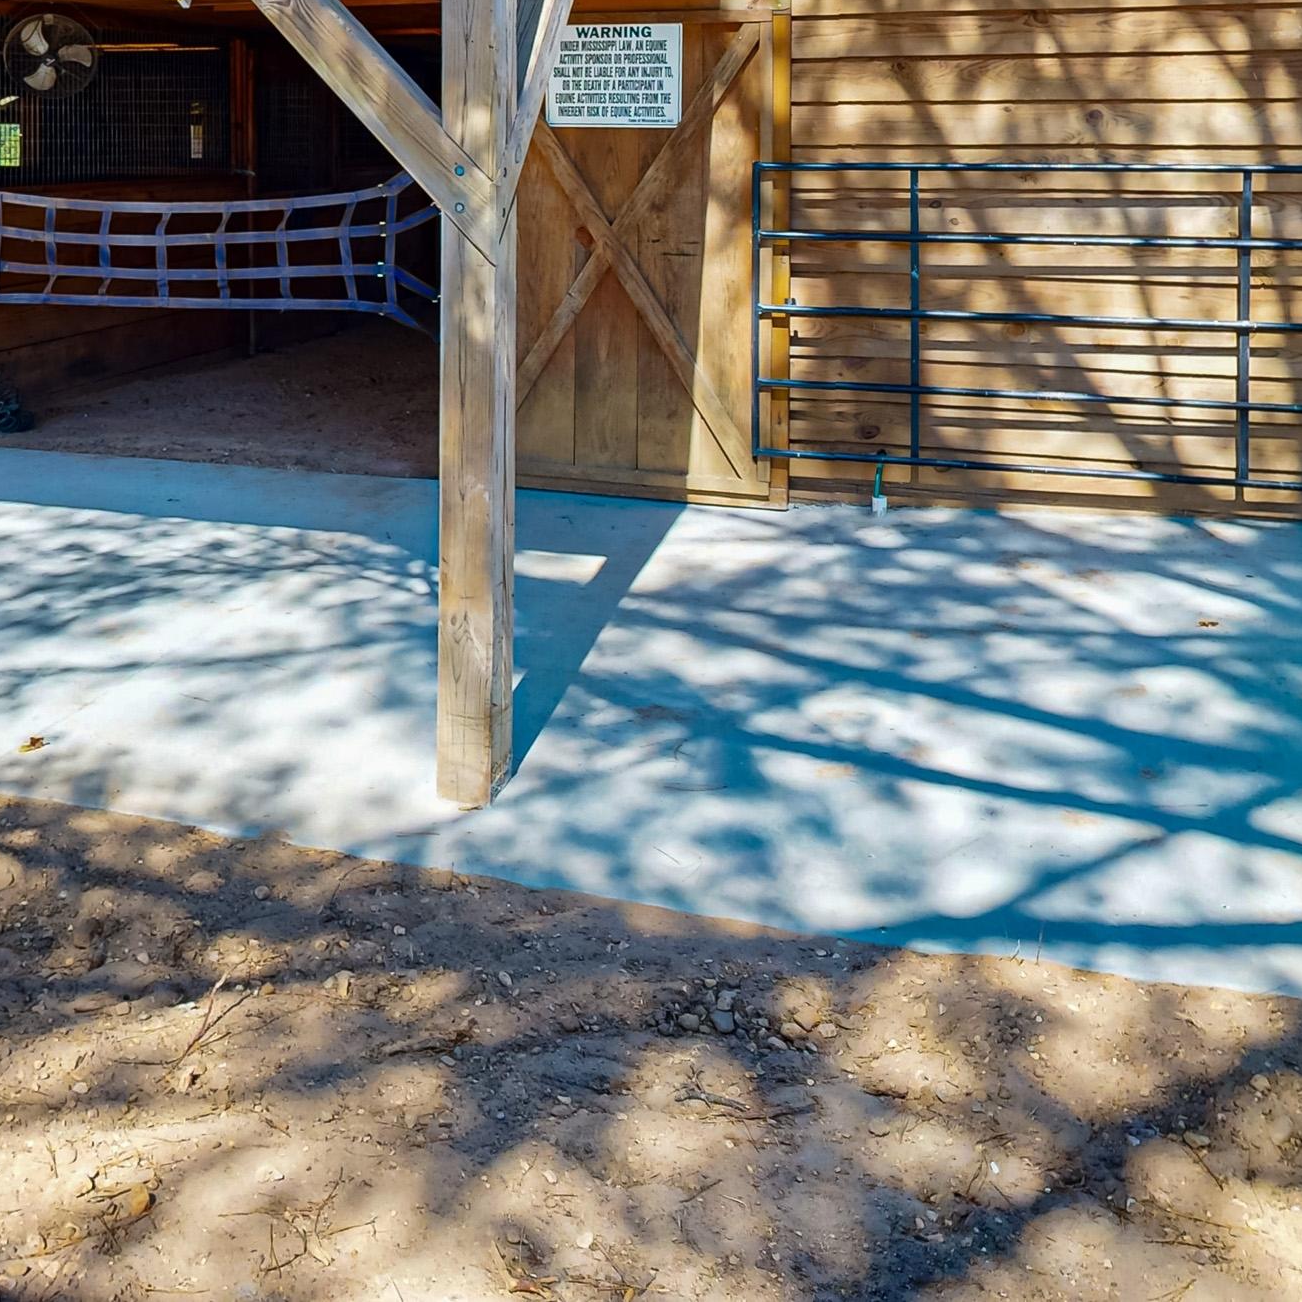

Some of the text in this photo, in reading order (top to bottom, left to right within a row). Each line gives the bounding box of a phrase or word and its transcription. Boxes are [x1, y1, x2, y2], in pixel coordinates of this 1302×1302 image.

[576, 27, 652, 38] WARNING
[560, 40, 579, 51] UNDER
[582, 40, 617, 51] MISSISSIPPI
[635, 40, 643, 51] AN
[646, 40, 667, 52] EQUINE
[560, 53, 667, 64] ACTIVITY SPONSOR OR PROFESSIONAL
[553, 67, 673, 78] SHALL NOT BE LIABLE FOR ANY INJURY TO,
[563, 80, 664, 90] OR THE DEATH OF A PARTICIPANT IN
[556, 93, 671, 104] EQUINE ACTIVITIES RESULTING FROM THE
[558, 106, 585, 117] INHERENT
[587, 106, 600, 117] RISK
[602, 106, 609, 117] OF
[611, 106, 632, 118] EQUINE
